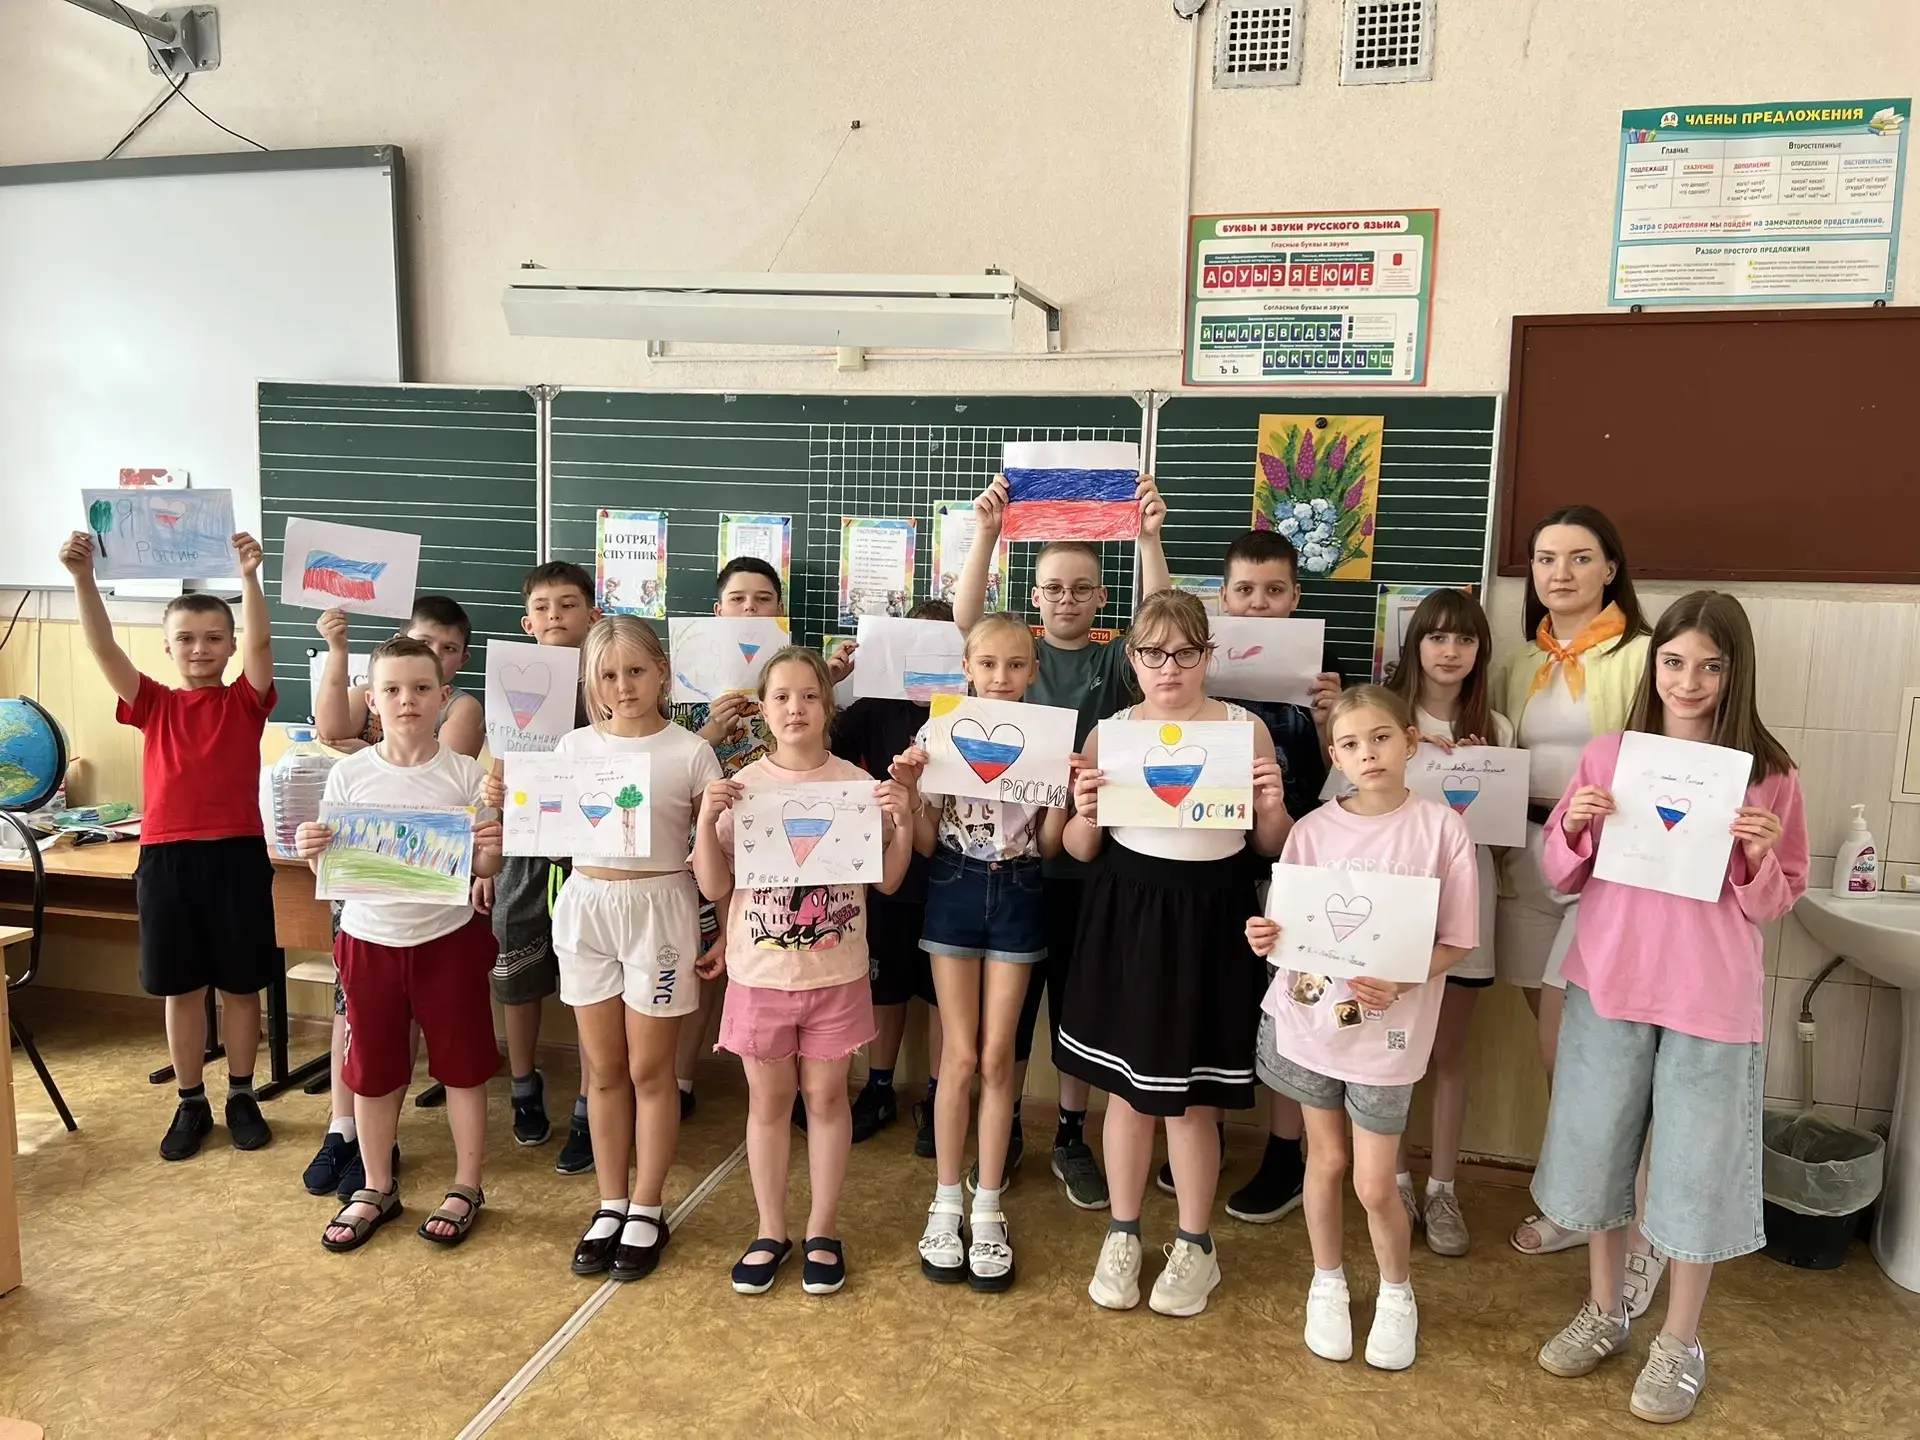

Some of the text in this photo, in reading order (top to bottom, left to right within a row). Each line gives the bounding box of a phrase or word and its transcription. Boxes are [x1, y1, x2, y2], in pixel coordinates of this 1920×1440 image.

[1685, 108, 1864, 125] ЧЛЕНЫ ПРЕДЛОЖЕНИЯ
[1683, 163, 1715, 171] СКАЗУЕМОЕ
[1733, 161, 1771, 170] ДОПОЛНЕНИЕ
[1844, 158, 1893, 166] ОБСТОЯТЕЛЬСТВО
[1630, 165, 1669, 173] ПОДЛЕЖАЩЕЕ
[1222, 220, 1401, 232] БУКВЫ И ЗВУКИ РУССКОГО ЯЗЫКА
[1630, 223, 1656, 231] Завтра
[1664, 221, 1708, 230] родителями
[1723, 219, 1752, 228] пойдём
[1765, 218, 1822, 226] замечательное
[116, 499, 134, 539] Я
[615, 533, 657, 546] ОТРЯД
[136, 540, 200, 564] Россию
[597, 549, 663, 560] «СПУТНИК»
[999, 777, 1068, 807] РОССИЯ
[652, 968, 676, 1005] NYC
